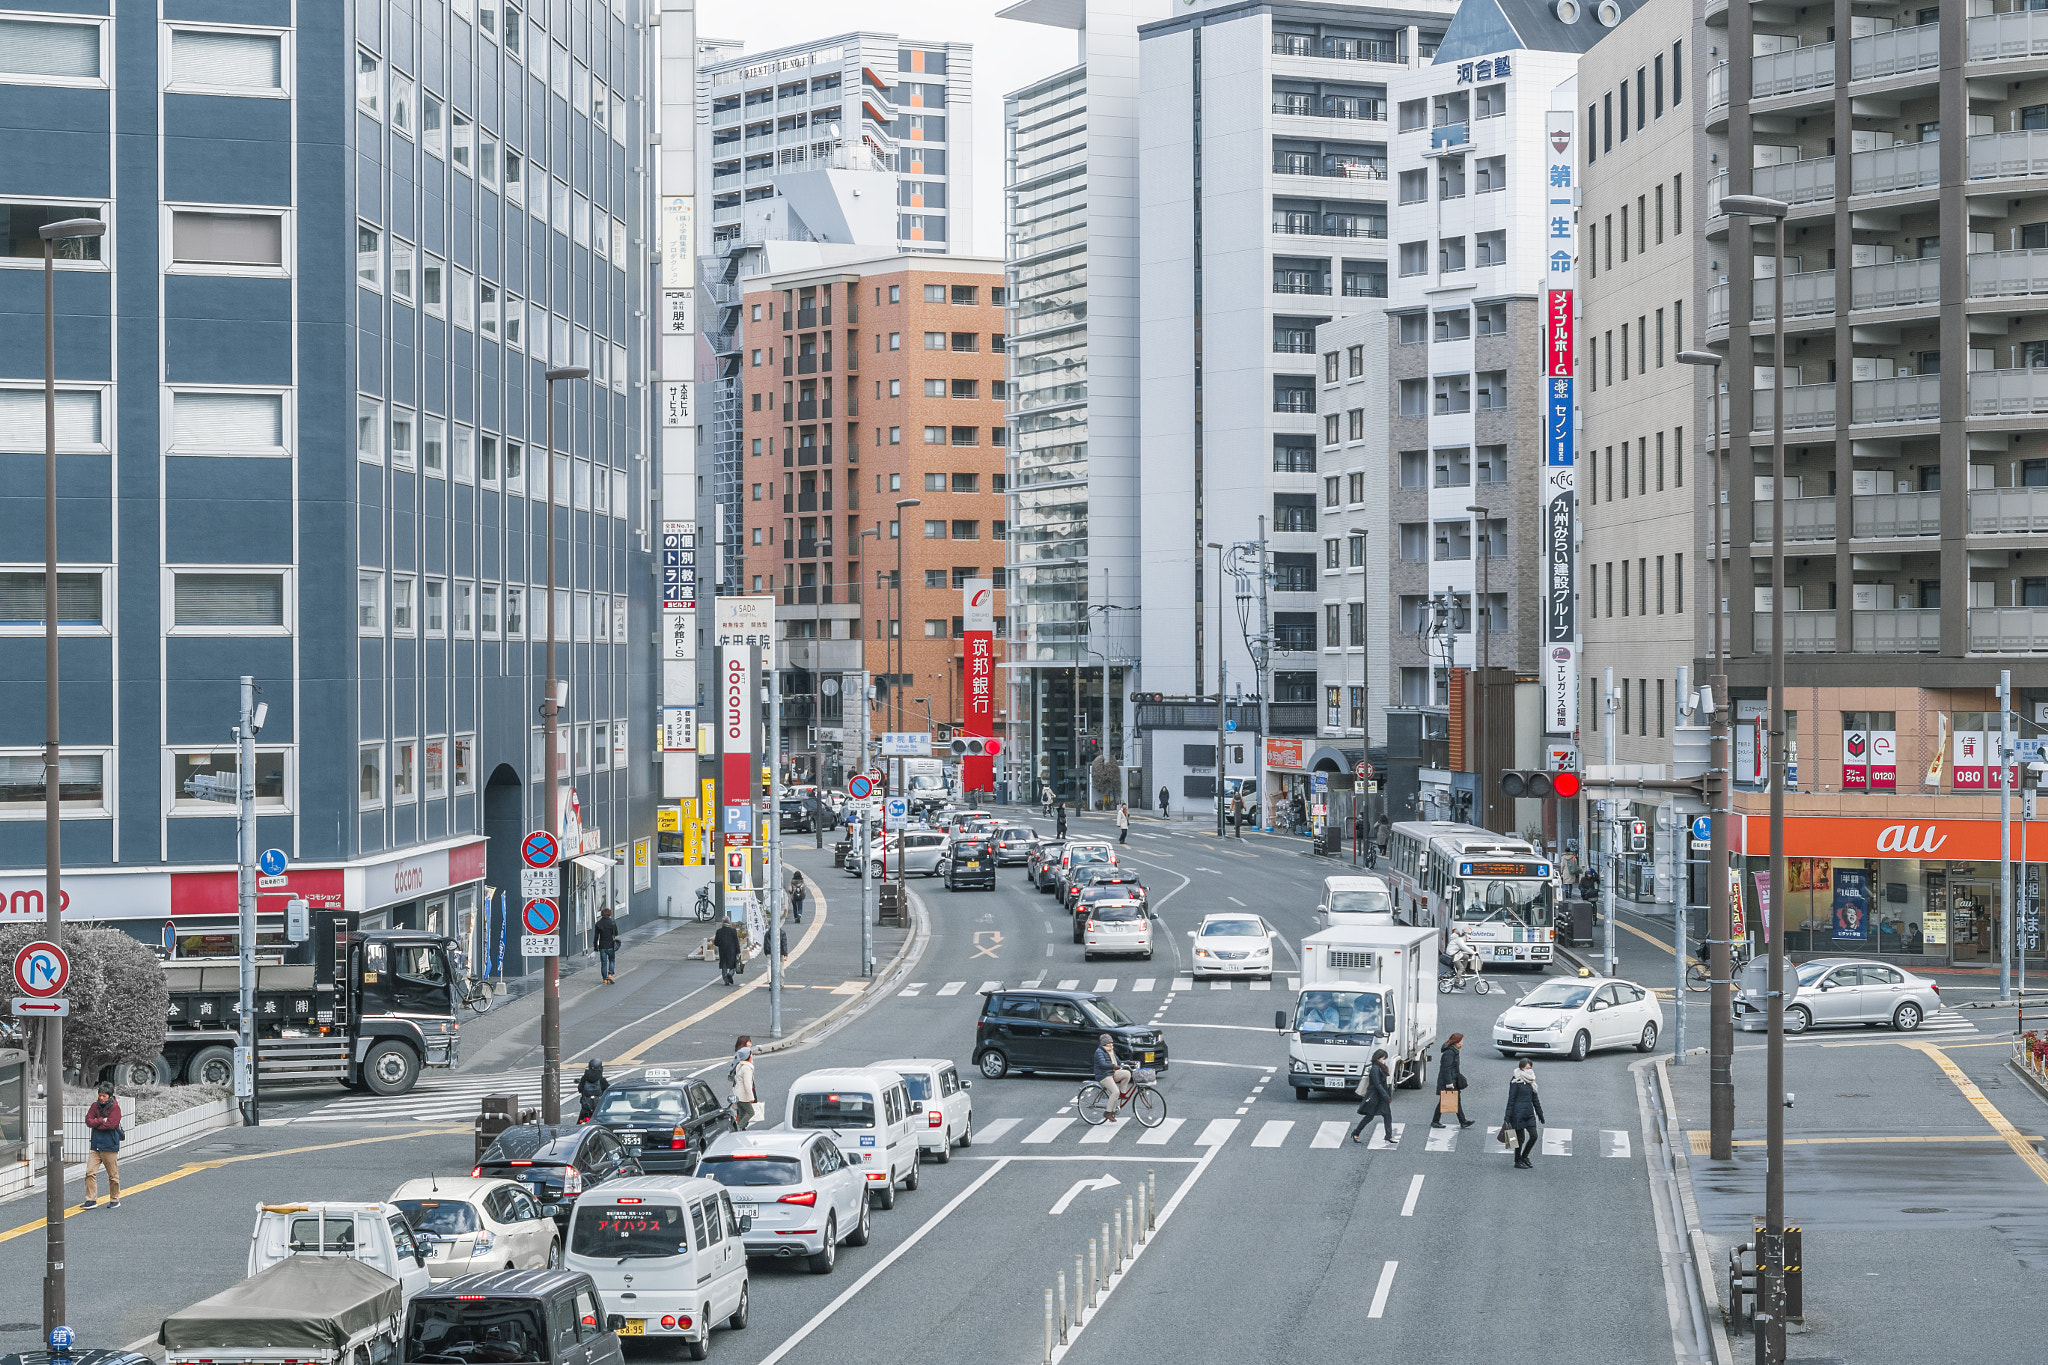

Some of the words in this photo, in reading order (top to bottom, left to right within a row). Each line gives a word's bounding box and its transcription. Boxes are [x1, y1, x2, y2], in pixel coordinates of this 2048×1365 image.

[1550, 165, 1571, 272] 第一生命
[673, 311, 684, 330] 朋栄
[1555, 291, 1568, 375] メイプルホーム
[1555, 405, 1567, 439] セノン
[665, 535, 677, 599] のトライ
[681, 535, 694, 599] 個別教室
[1554, 499, 1569, 638] 九州みらい建設グループ
[719, 634, 770, 649] 佐田病院
[972, 638, 989, 714] 筑邦銀行
[729, 660, 745, 739] docomo
[1557, 665, 1567, 726] エレガンス福岡
[1872, 771, 1895, 781] (0120)
[1957, 771, 1981, 782] 080
[728, 808, 740, 824] P
[737, 821, 747, 831] 有
[1876, 825, 1947, 853] au
[395, 862, 422, 894] docomo
[528, 888, 553, 896] ここまで
[2028, 865, 2039, 949] 負担します
[599, 1220, 660, 1231] アイハウス
